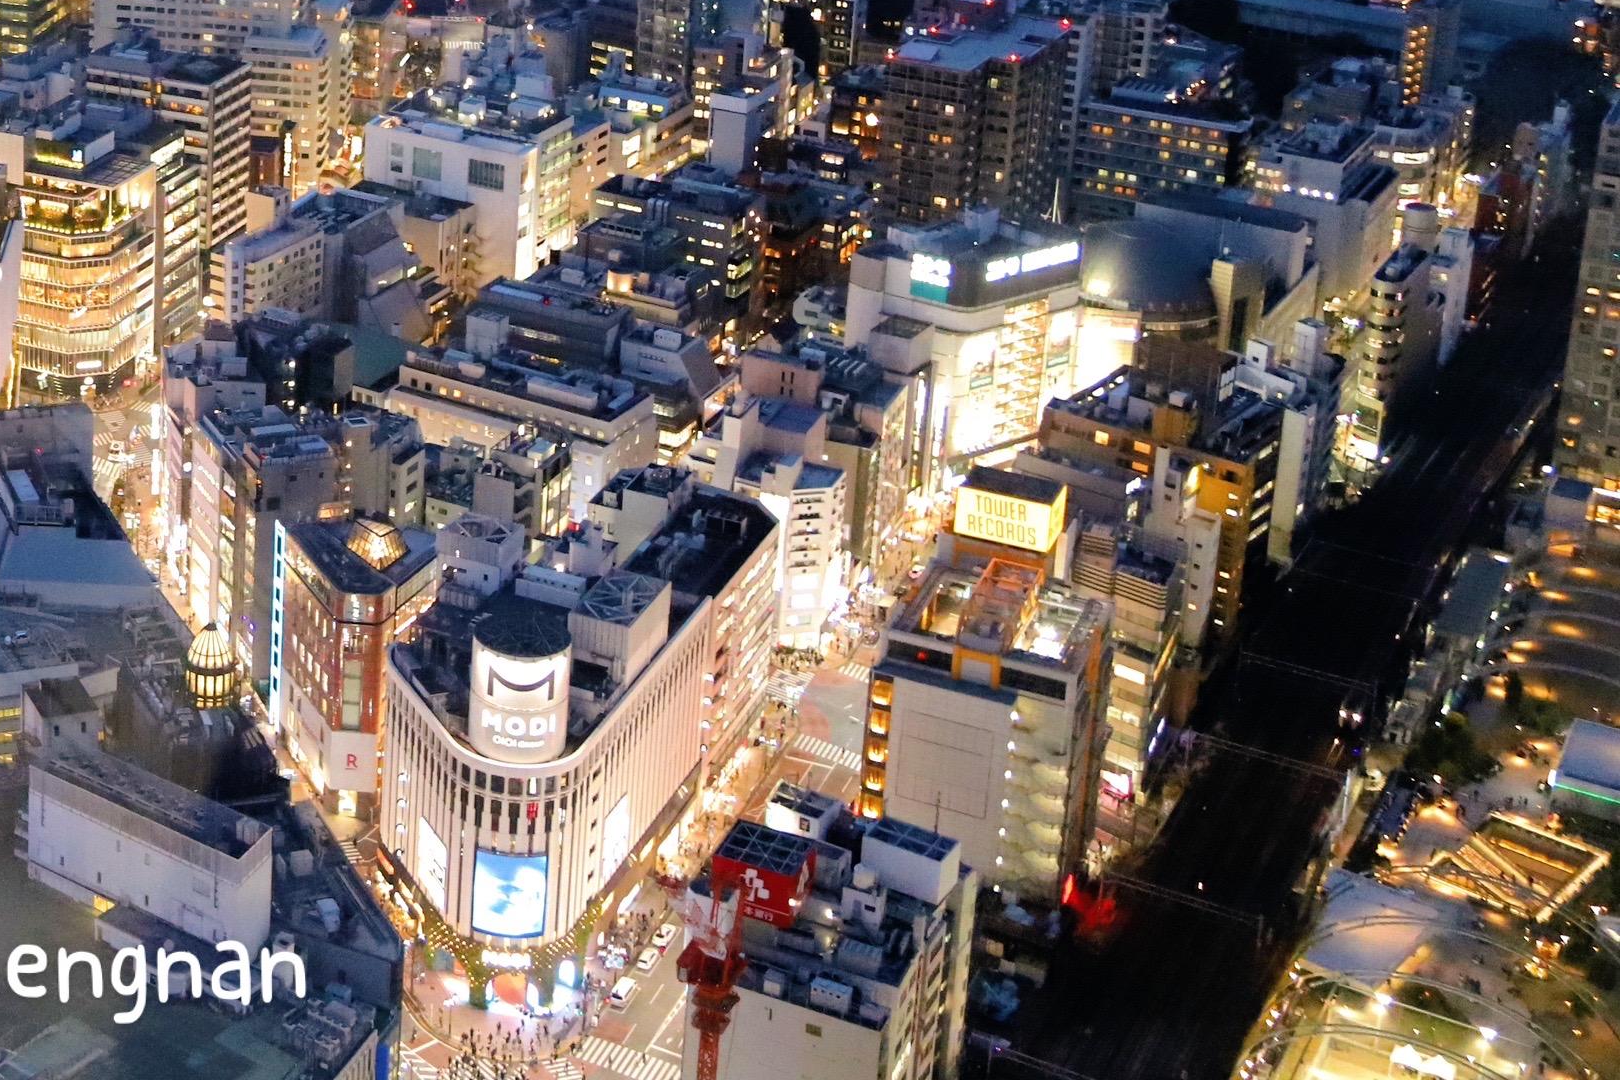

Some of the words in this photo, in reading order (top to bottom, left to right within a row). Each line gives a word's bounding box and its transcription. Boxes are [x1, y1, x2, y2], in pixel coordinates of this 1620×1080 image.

[975, 494, 1027, 522] TOWER
[967, 514, 1037, 546] RECORDS
[481, 708, 557, 737] MODI
